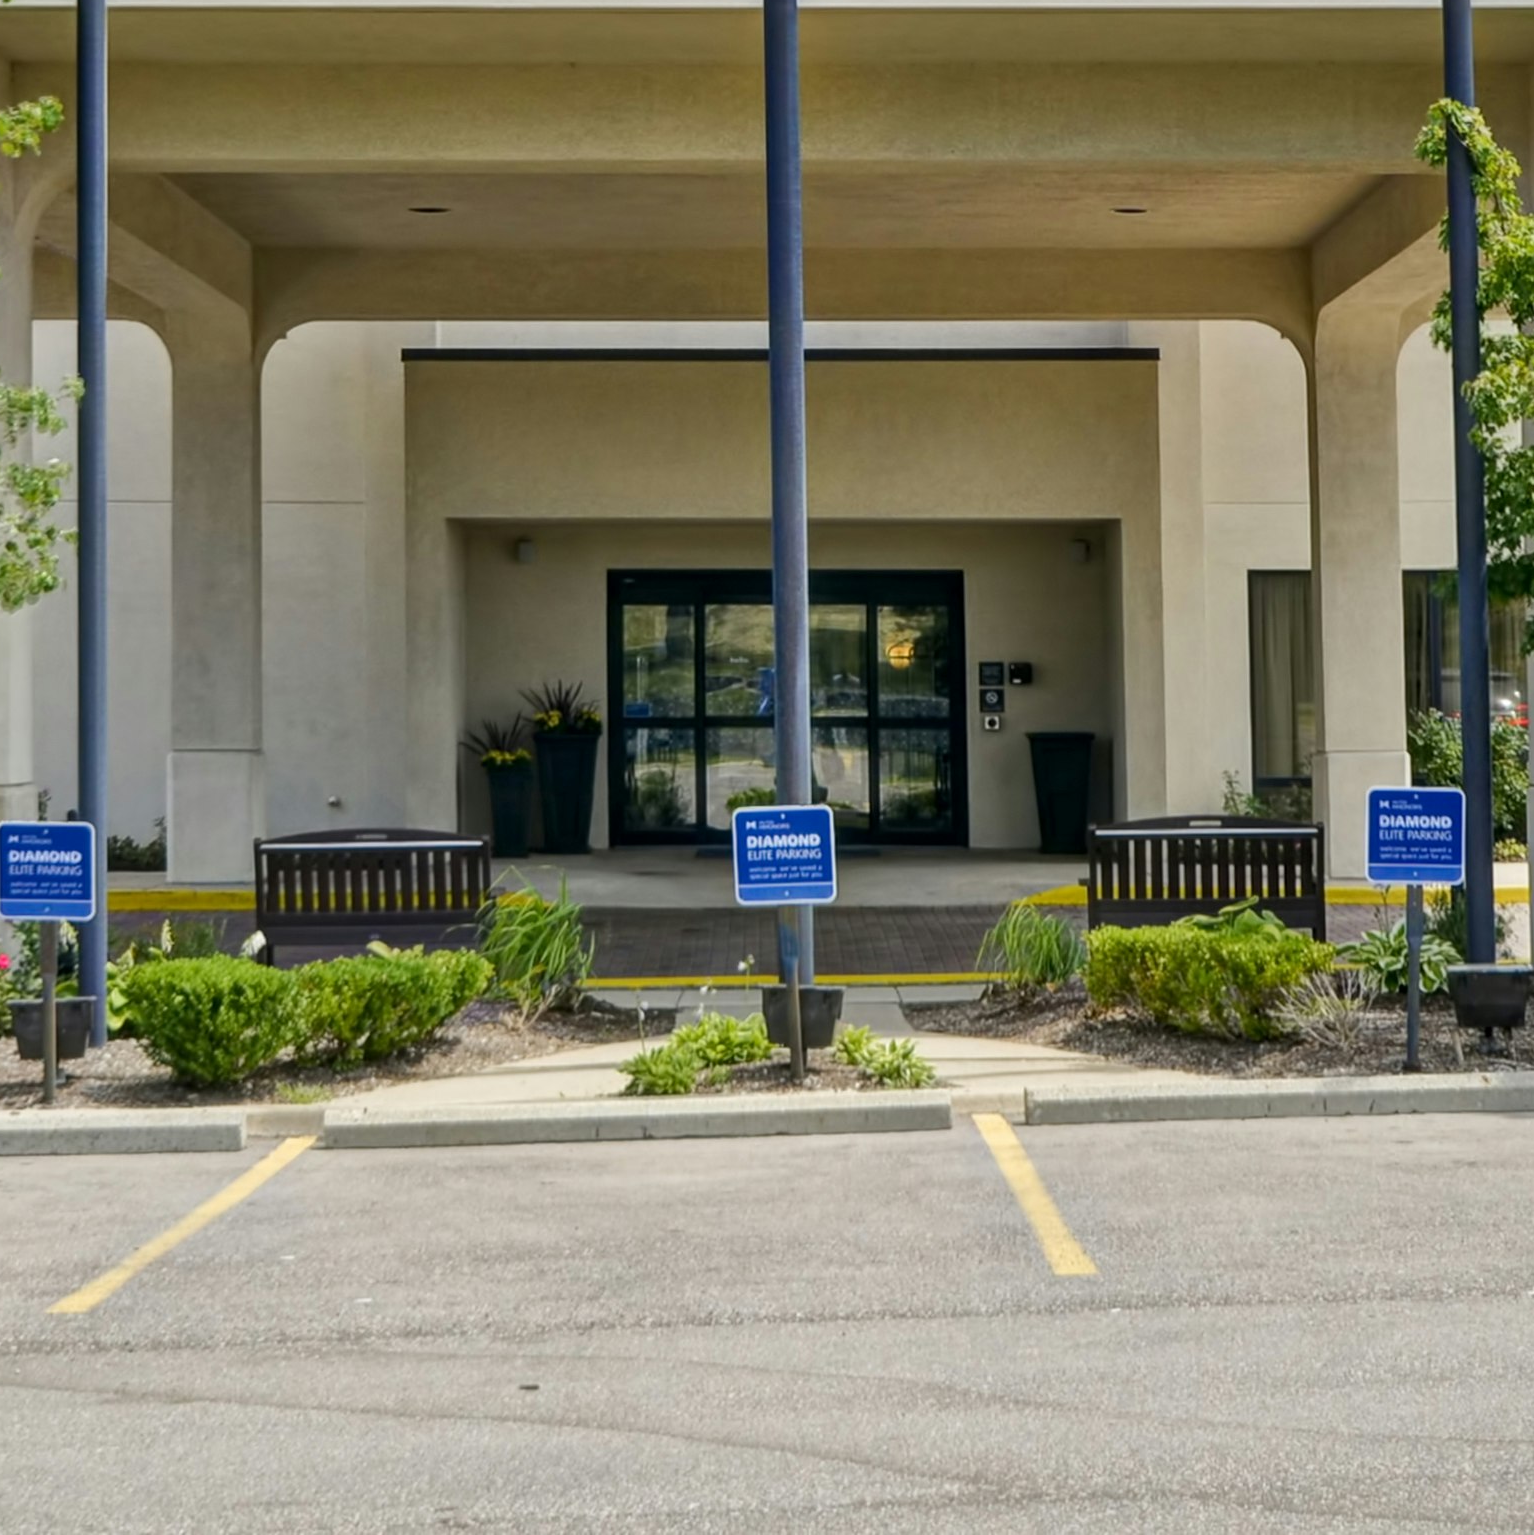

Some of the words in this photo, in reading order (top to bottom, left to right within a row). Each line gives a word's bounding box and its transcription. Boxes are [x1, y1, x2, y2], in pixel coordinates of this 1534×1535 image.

[1379, 814, 1452, 829] DIAMOND
[747, 833, 821, 849] DIAMOND
[1380, 830, 1404, 841] ELITE
[1407, 830, 1452, 841] PARKING
[9, 850, 82, 863] DIAMOND
[747, 850, 773, 861] ELITE
[776, 848, 822, 860] PARKING
[9, 865, 34, 875] ELITE
[37, 865, 82, 876] PARKING
